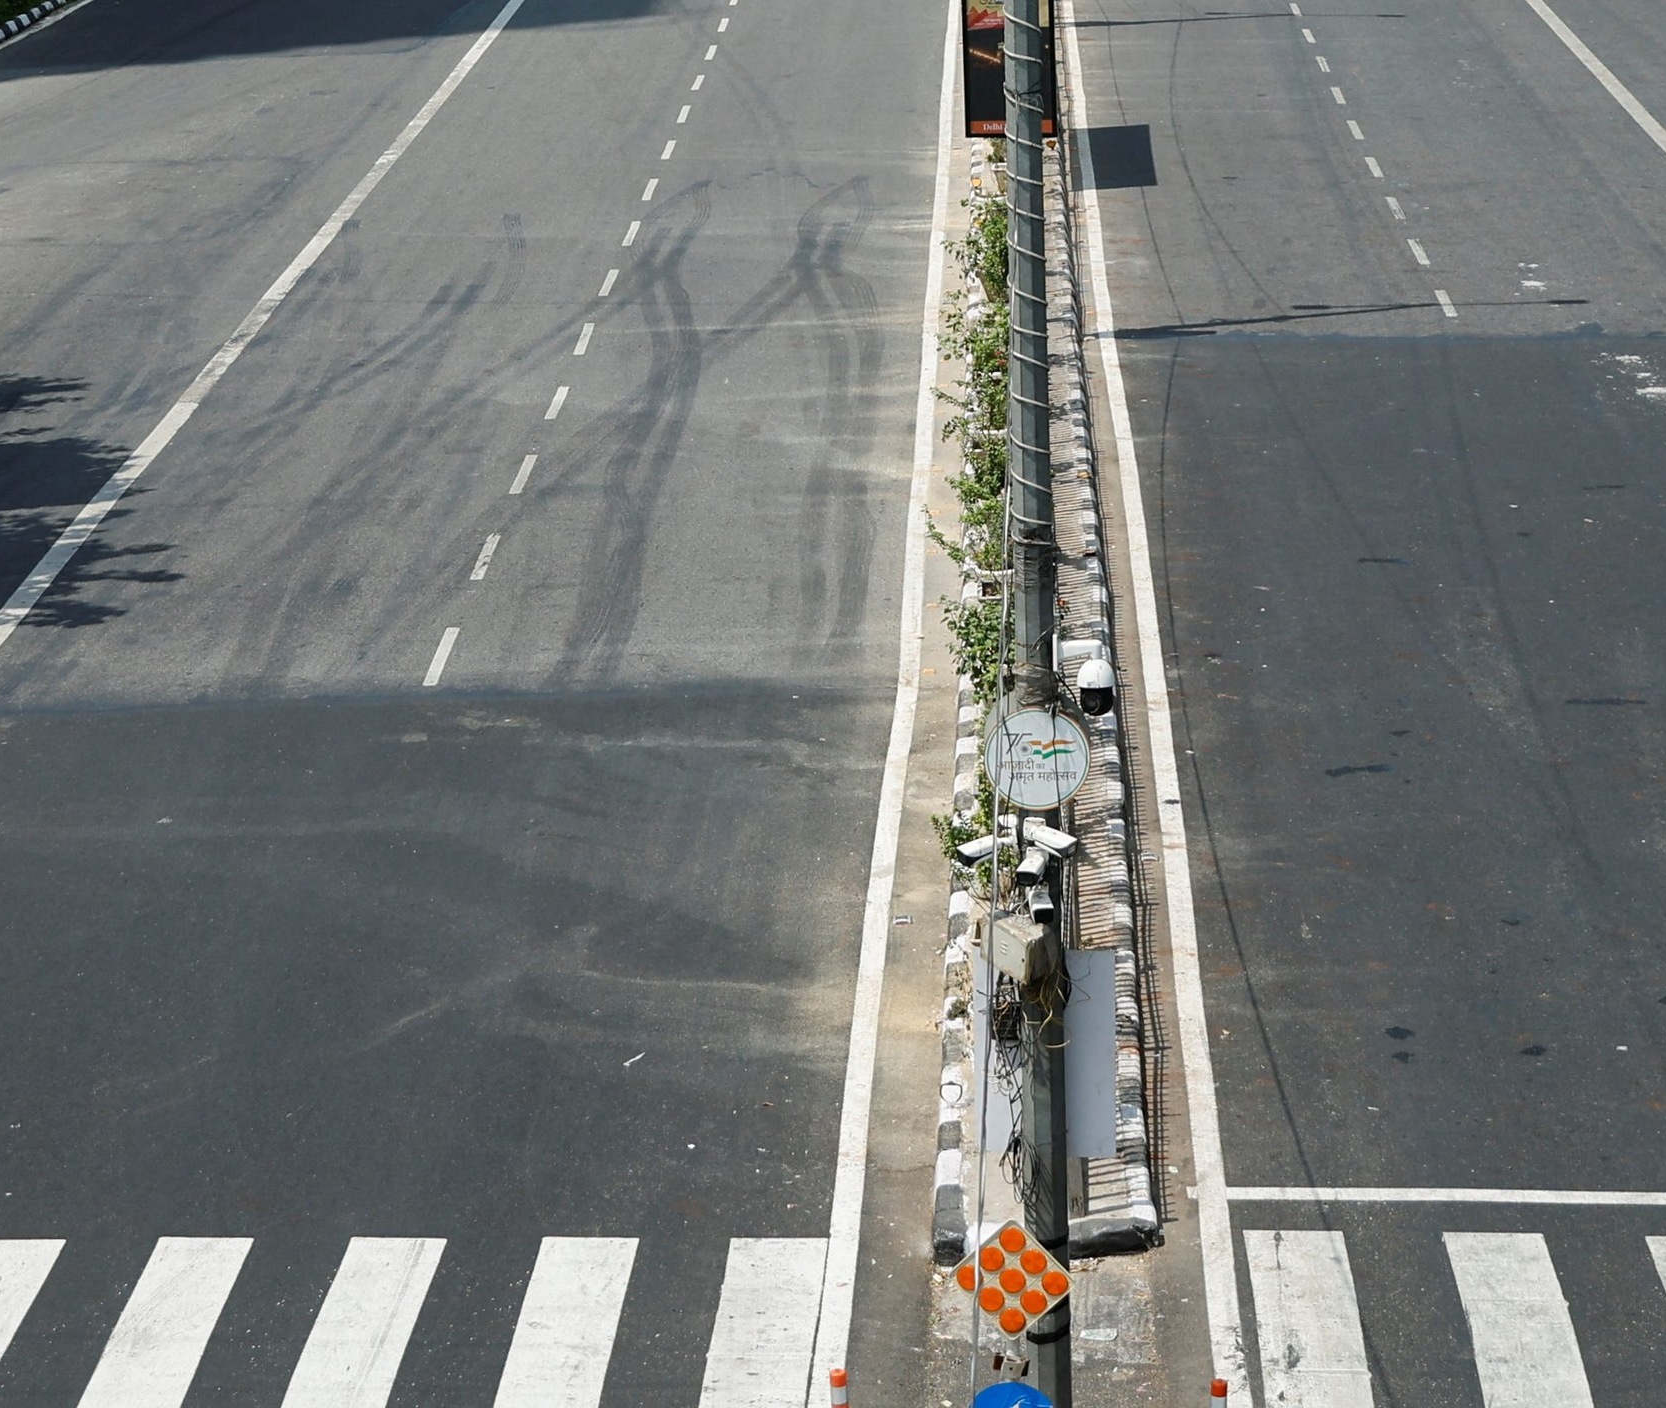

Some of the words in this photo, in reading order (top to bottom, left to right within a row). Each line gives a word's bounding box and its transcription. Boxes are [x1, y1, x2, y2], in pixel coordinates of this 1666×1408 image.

[983, 123, 1003, 131] Delhi
[1036, 762, 1046, 770] का
[1008, 771, 1035, 785] अमृत
[1037, 768, 1077, 782] महोत्सव
